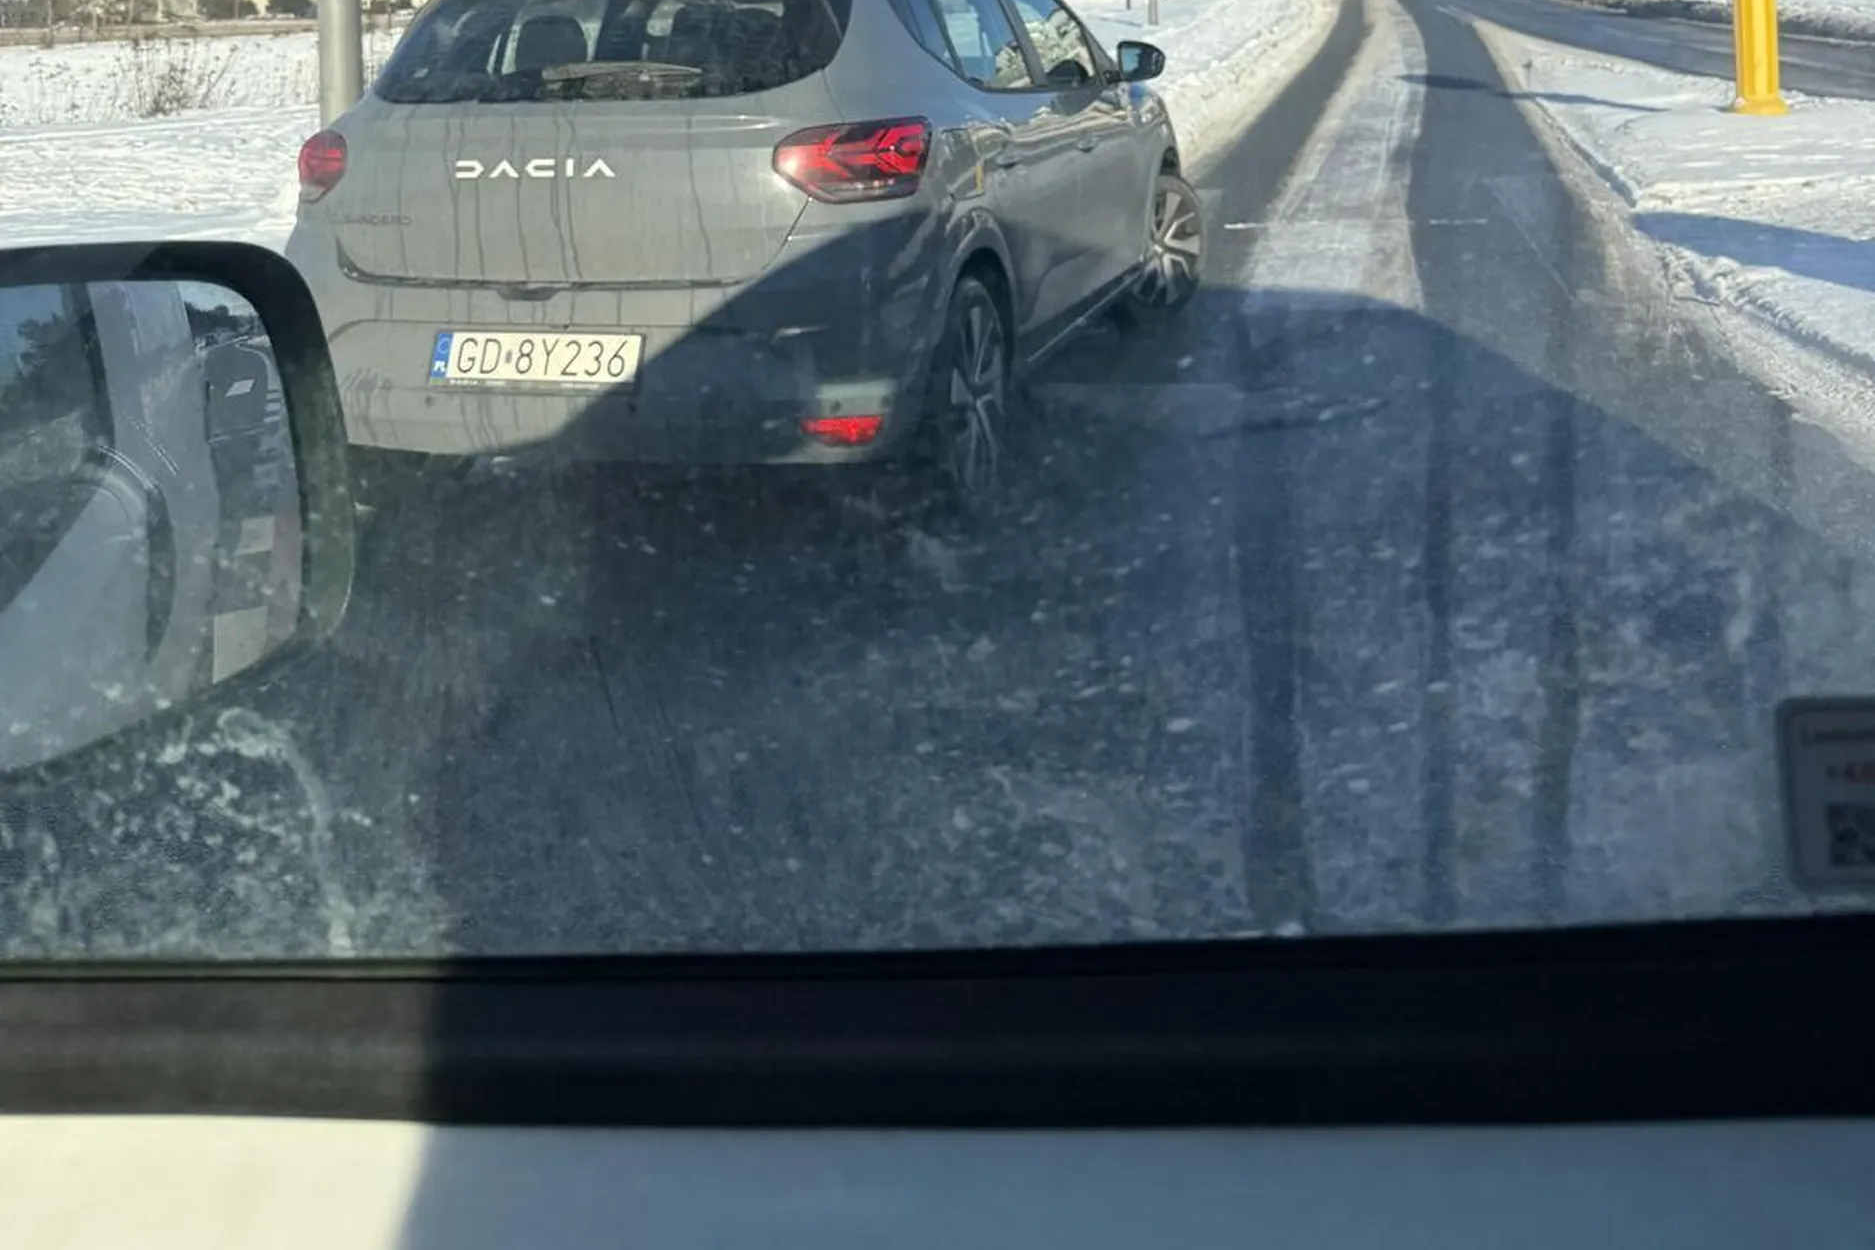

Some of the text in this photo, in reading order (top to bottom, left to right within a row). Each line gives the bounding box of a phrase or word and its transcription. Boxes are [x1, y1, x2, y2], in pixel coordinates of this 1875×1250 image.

[455, 158, 616, 179] DACIA
[456, 337, 628, 378] GD 8Y236
